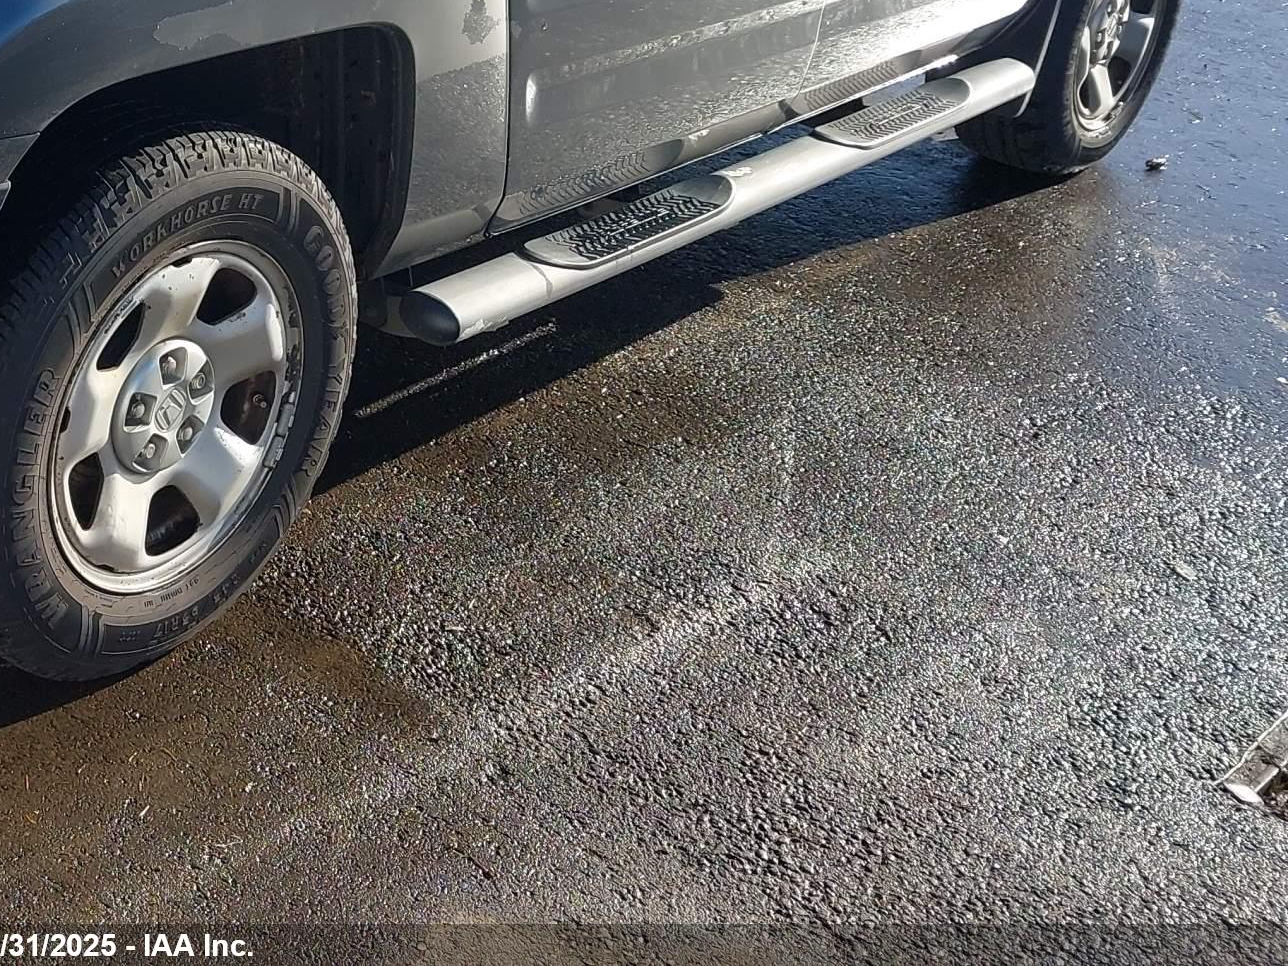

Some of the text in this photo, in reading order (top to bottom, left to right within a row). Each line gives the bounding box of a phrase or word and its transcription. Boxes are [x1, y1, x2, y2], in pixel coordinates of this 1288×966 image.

[112, 193, 263, 279] WORKHORSE HT
[11, 367, 70, 629] WRANGLER
